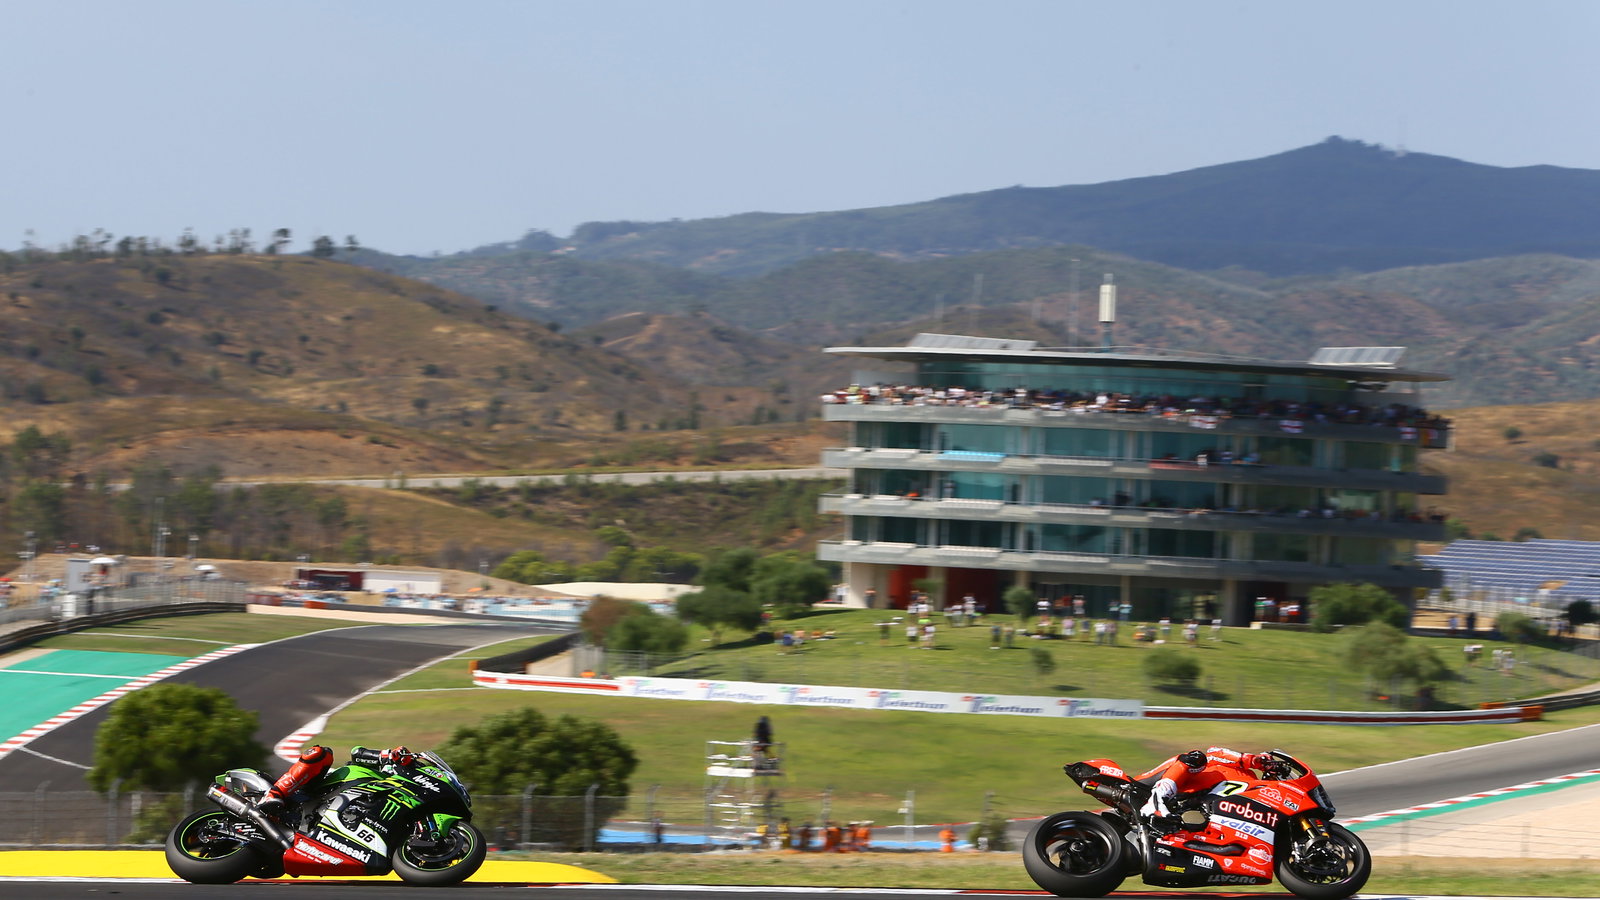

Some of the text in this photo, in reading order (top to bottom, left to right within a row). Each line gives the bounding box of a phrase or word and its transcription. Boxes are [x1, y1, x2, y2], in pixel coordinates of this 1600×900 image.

[412, 775, 440, 793] Ninja
[1223, 782, 1243, 796] 7
[1219, 801, 1279, 827] aruba.it
[356, 829, 375, 843] 66
[1220, 819, 1265, 836] valsir
[316, 830, 371, 864] Kawasaki
[1193, 855, 1215, 868] FIAMM
